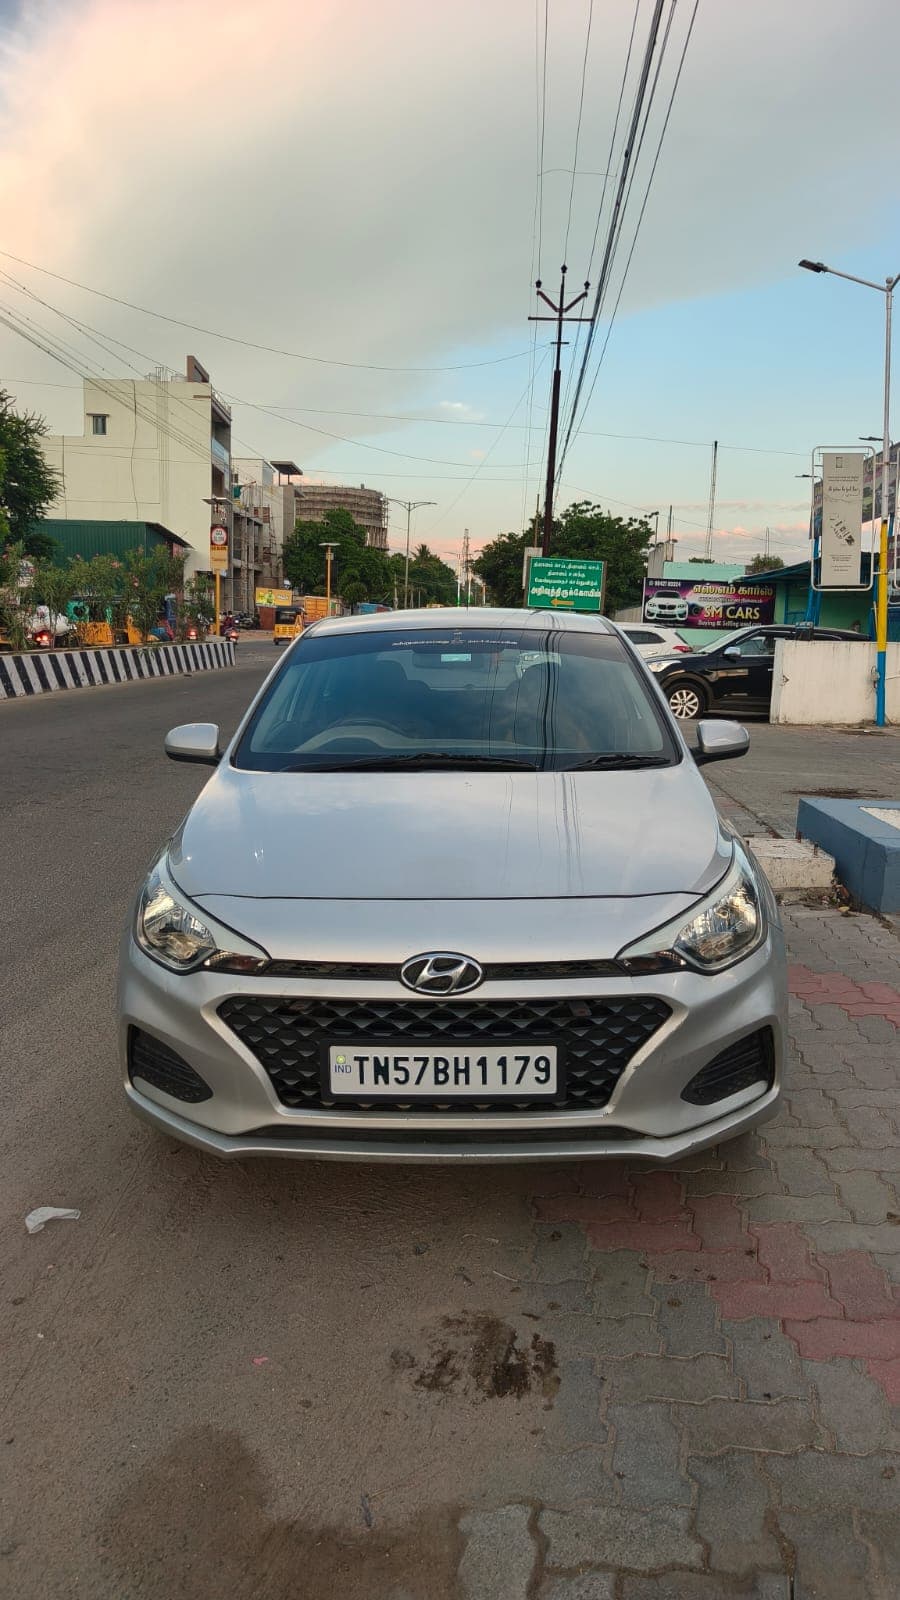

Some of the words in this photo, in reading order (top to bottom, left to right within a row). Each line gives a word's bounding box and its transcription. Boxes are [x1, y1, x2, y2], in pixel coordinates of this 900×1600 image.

[704, 605, 723, 619] SM
[726, 606, 760, 620] CARS
[334, 1064, 352, 1074] IND
[353, 1055, 551, 1086] TN57BH1179
